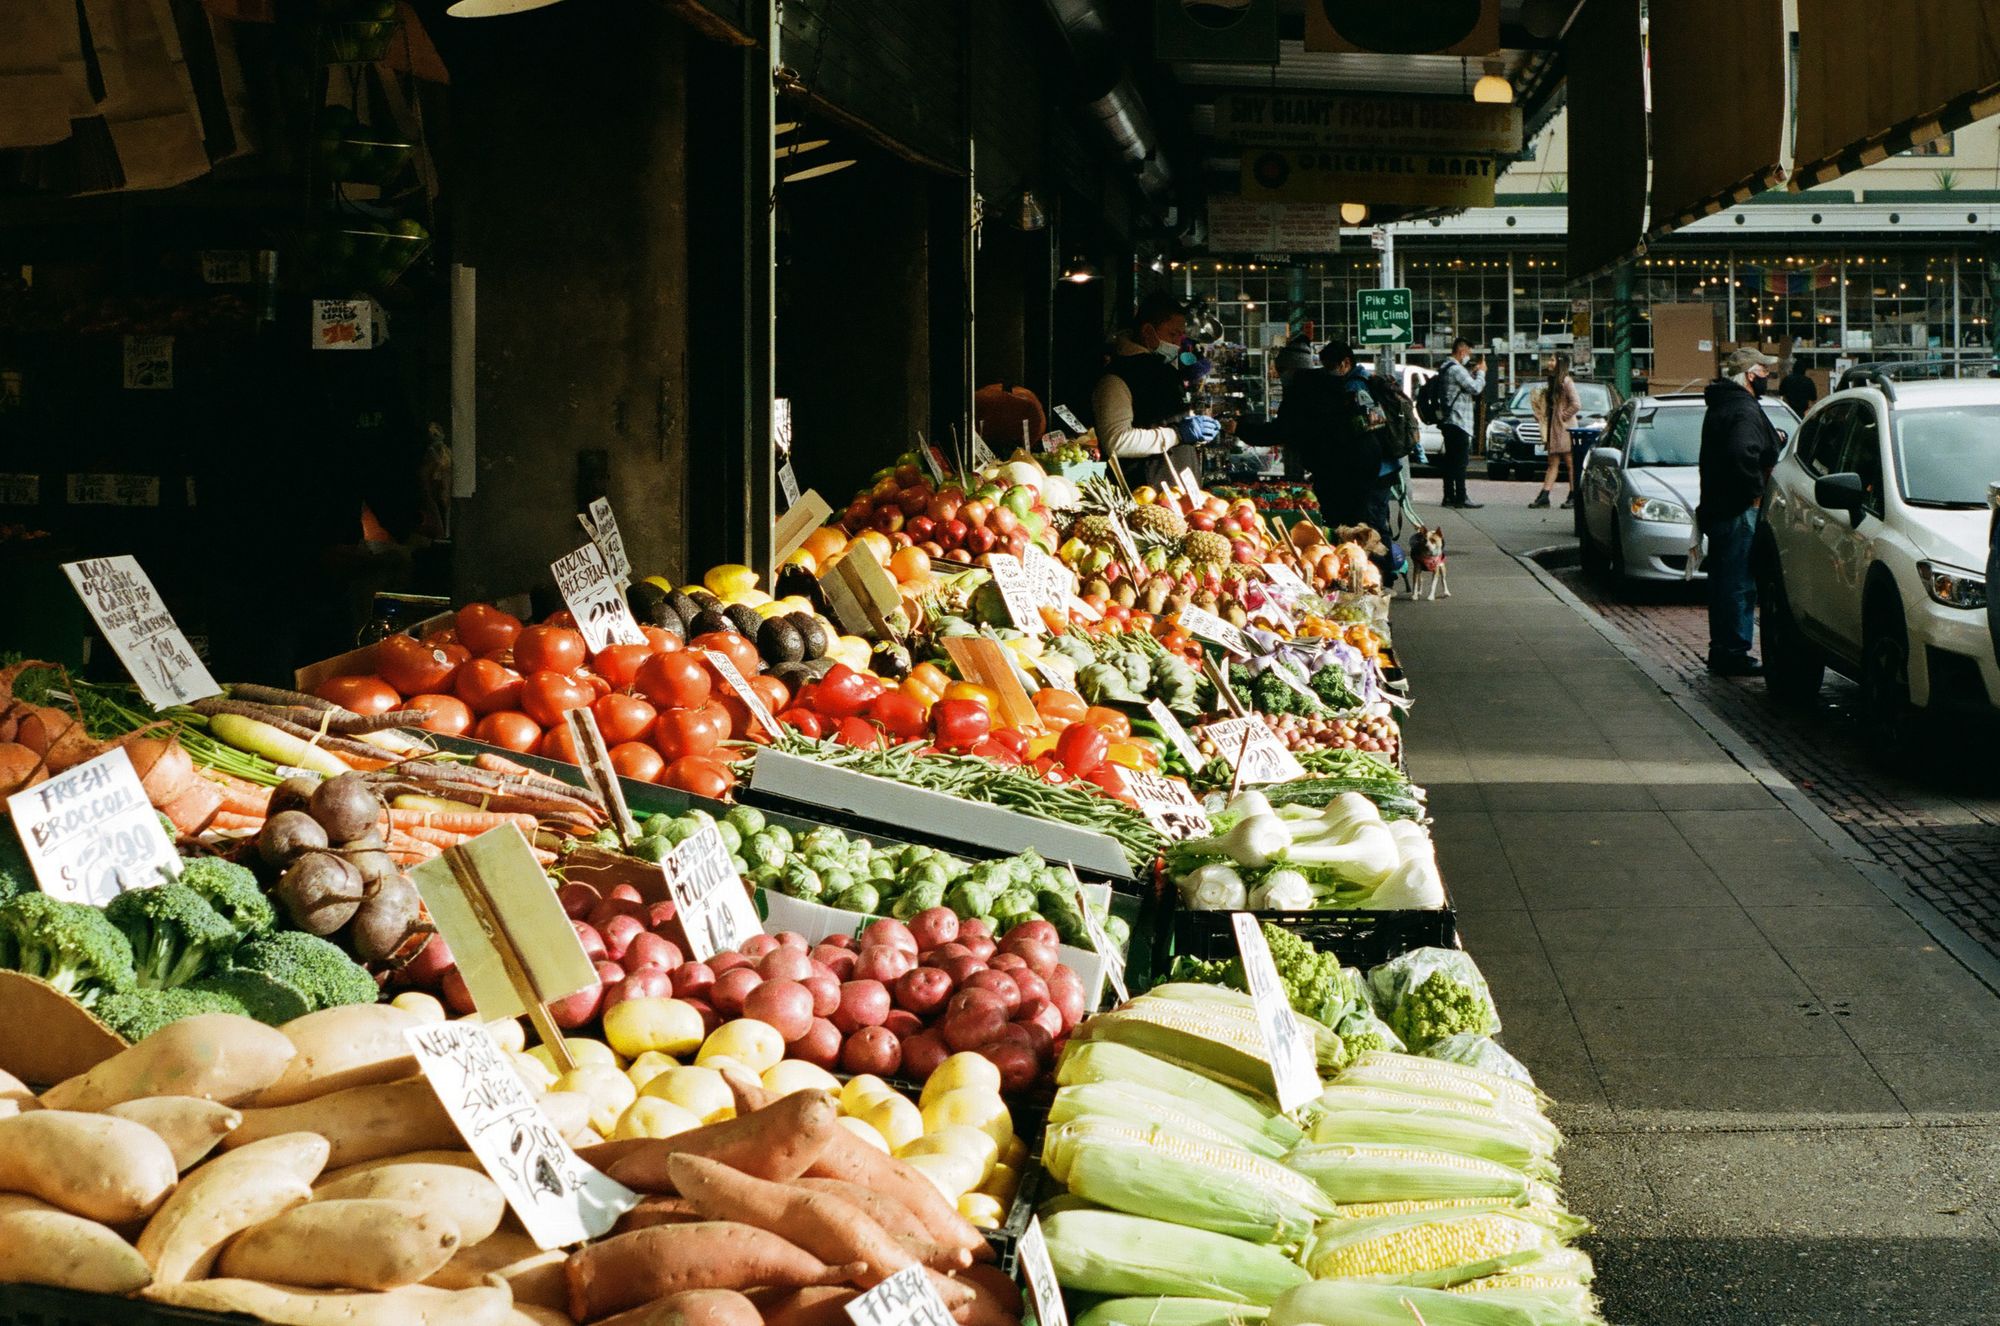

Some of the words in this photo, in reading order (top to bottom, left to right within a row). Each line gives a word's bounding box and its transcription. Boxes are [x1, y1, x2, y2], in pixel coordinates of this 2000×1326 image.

[1231, 97, 1265, 122] SHY
[1272, 98, 1333, 125] GIANT
[1340, 101, 1413, 129] FROZEN
[1298, 154, 1415, 173] ORIENTAL
[1428, 158, 1491, 176] MART
[1362, 311, 1378, 321] Hill
[1382, 310, 1409, 320] Climb
[1365, 295, 1386, 305] Pike
[1393, 294, 1404, 305] St
[561, 562, 609, 599] BEEFSTEAK
[35, 763, 113, 813] FRESH
[31, 785, 134, 848] BROCCOLI
[415, 1027, 460, 1058] NEW
[860, 1268, 925, 1325] FRESH
